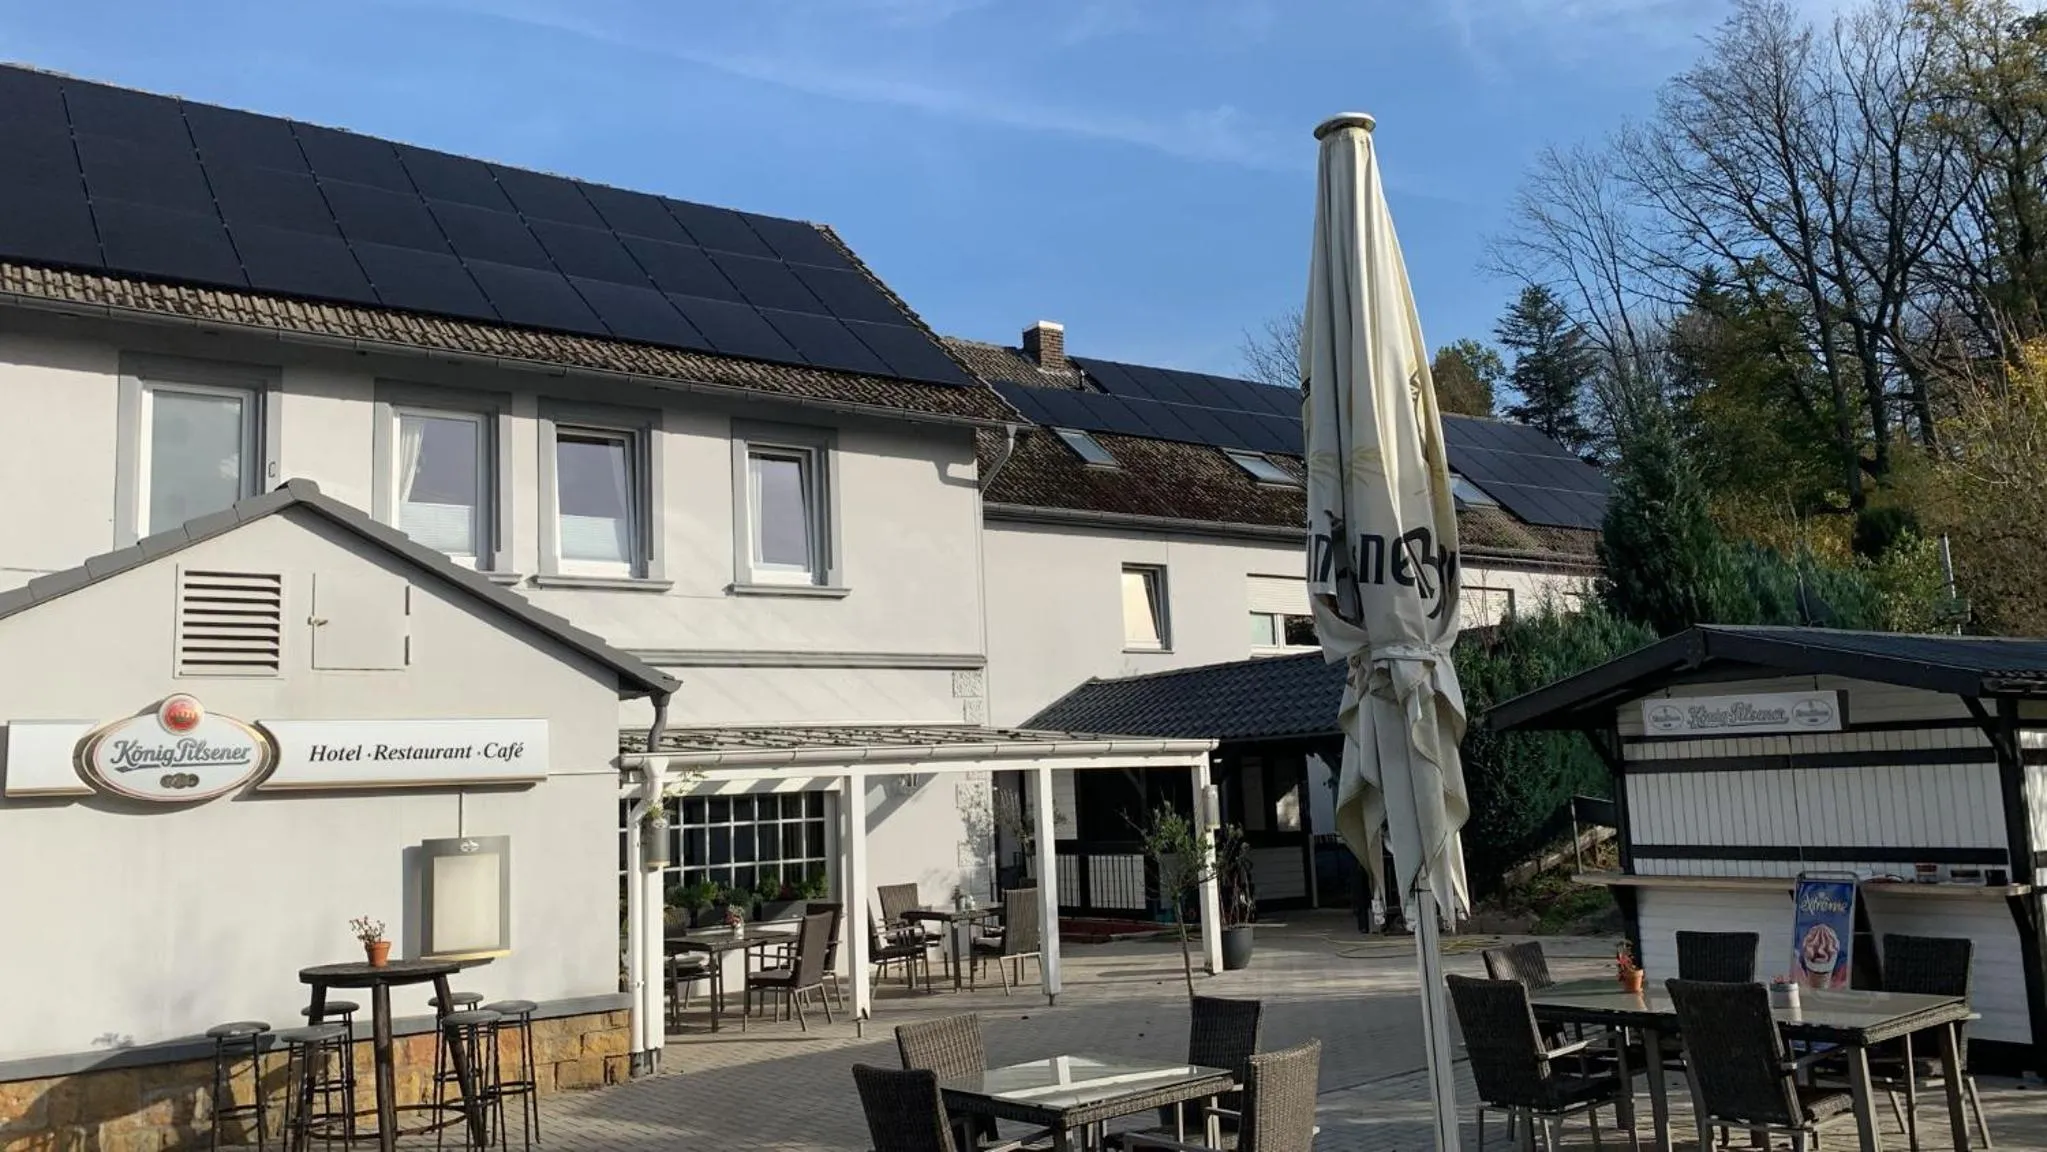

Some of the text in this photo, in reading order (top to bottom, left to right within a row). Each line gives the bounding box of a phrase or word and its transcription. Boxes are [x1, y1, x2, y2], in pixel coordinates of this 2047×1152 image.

[110, 737, 251, 765] König Pilsener
[309, 744, 362, 762] Hotel
